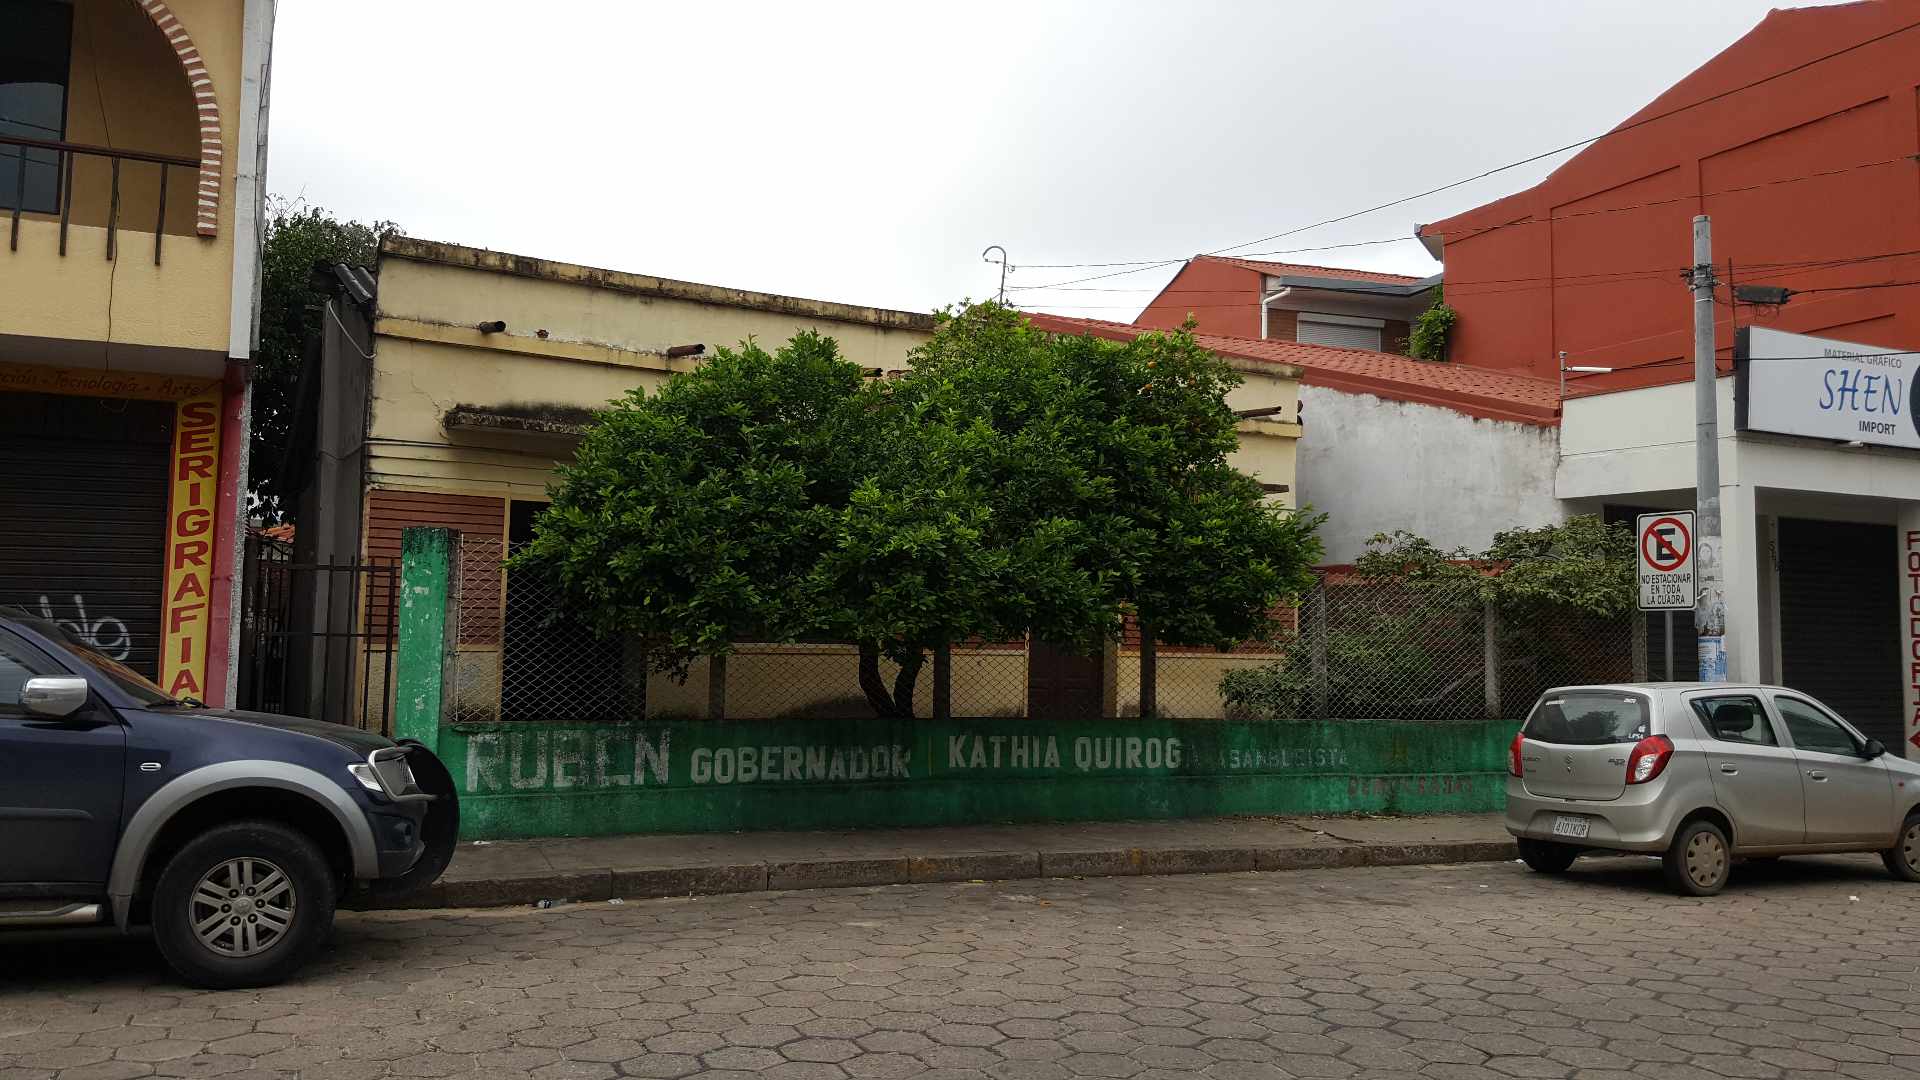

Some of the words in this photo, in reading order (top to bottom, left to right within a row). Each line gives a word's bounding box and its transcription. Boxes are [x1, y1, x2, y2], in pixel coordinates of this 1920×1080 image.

[1867, 355, 1902, 368] GRAFICO
[1819, 368, 1902, 416] SHEN
[1858, 420, 1896, 436] IMPORT
[170, 402, 216, 698] SERIGRAFIA
[1641, 575, 1651, 584] NO
[1652, 573, 1691, 584] ESTACIONAR
[1651, 585, 1660, 594] EN
[1662, 584, 1681, 594] TODA
[1647, 595, 1656, 605] LA
[1657, 594, 1685, 605] CUADRA
[948, 735, 1060, 769] KATHIA
[689, 745, 911, 785] GOBERNADOR
